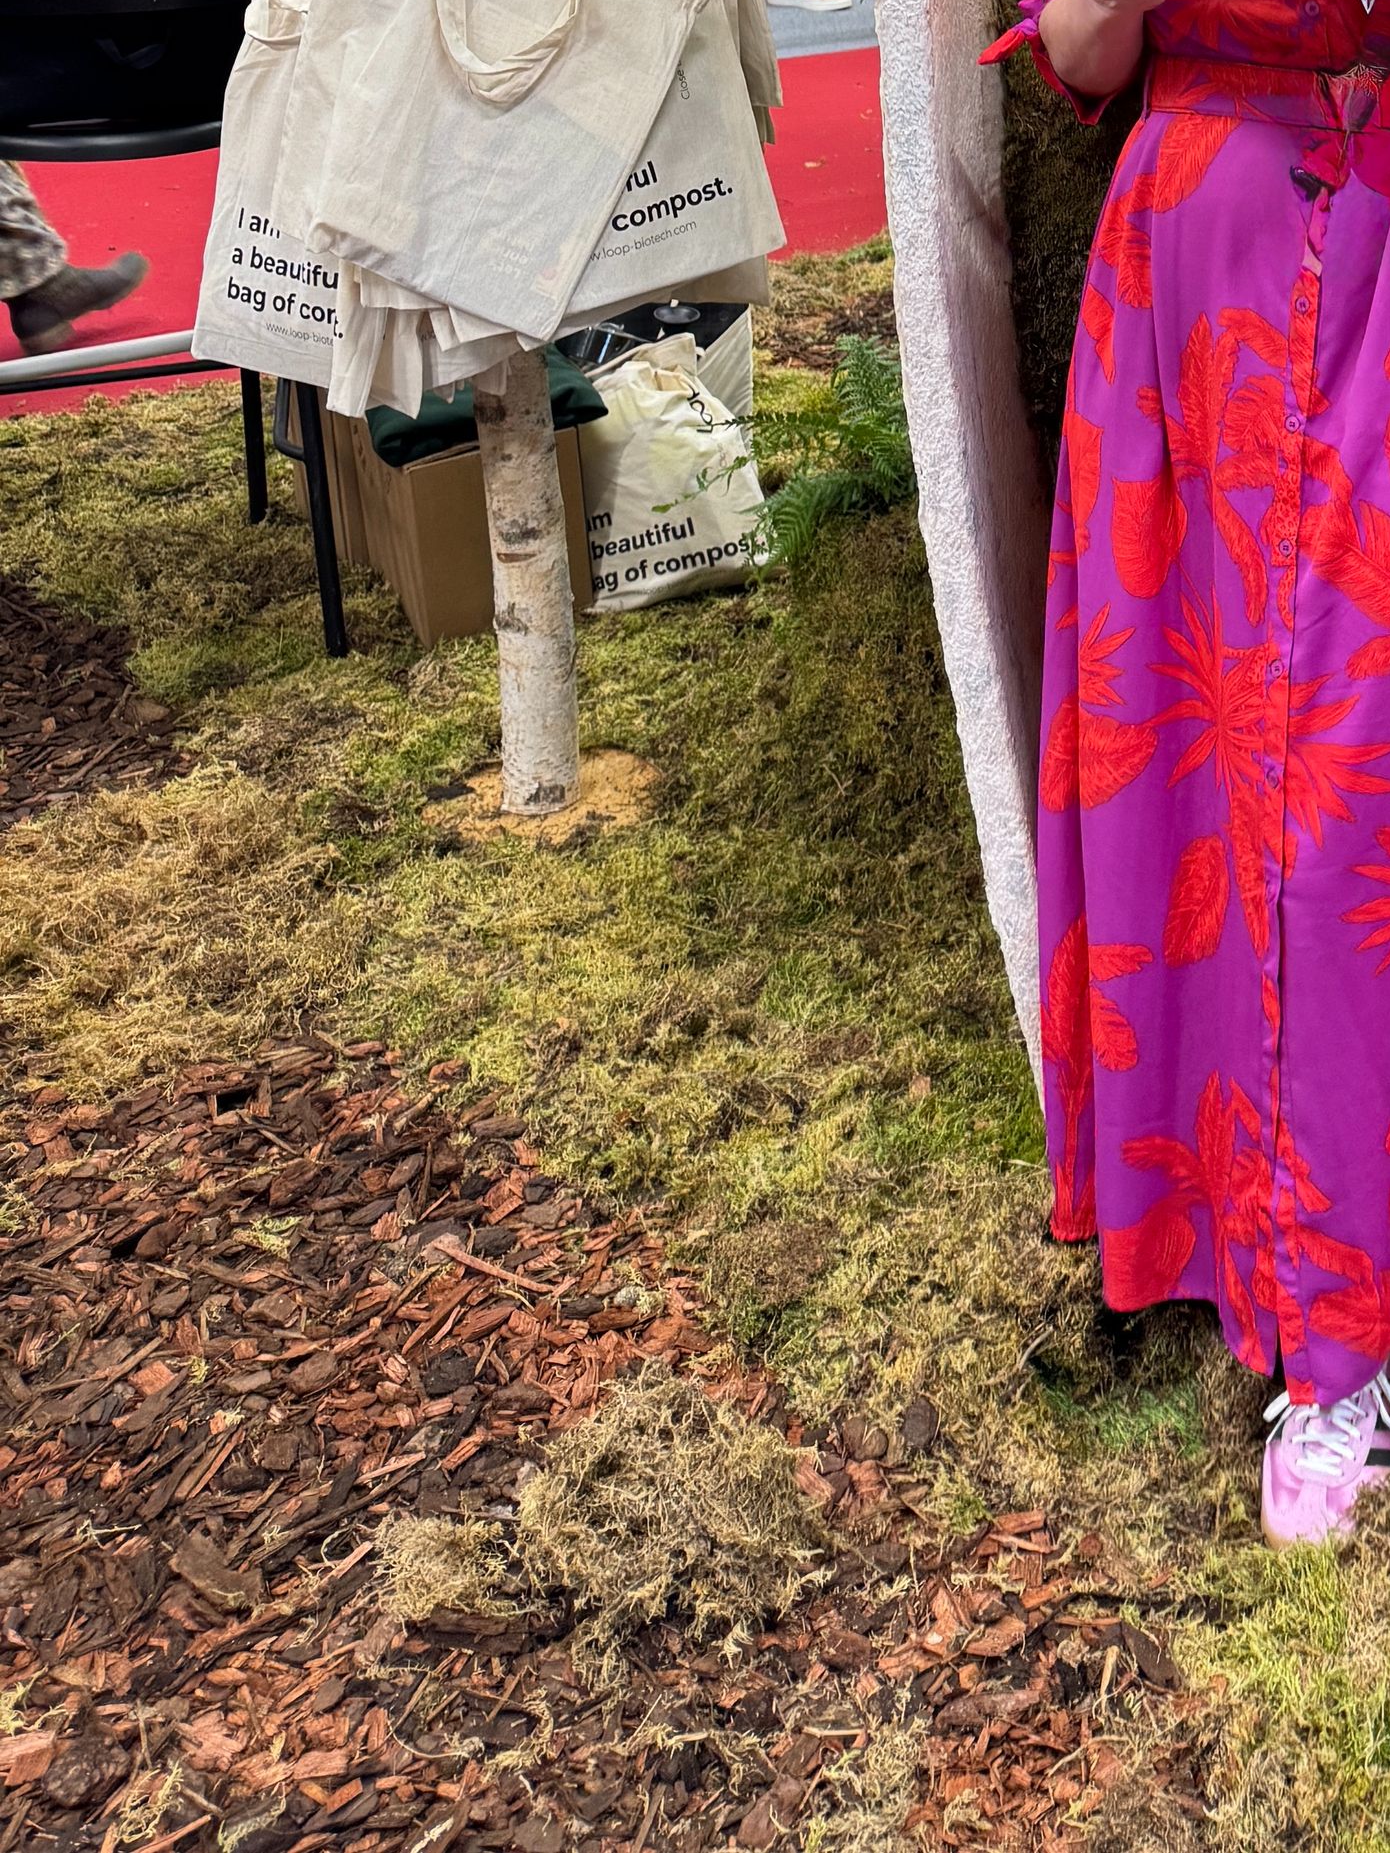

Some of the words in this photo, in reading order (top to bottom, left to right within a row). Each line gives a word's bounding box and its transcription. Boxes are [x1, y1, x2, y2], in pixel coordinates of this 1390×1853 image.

[612, 177, 733, 232] compost.
[232, 247, 243, 265] a
[250, 246, 339, 290] beautifu
[227, 276, 266, 312] bag
[273, 293, 296, 315] of
[591, 517, 695, 560] beautiful
[624, 559, 648, 583] of
